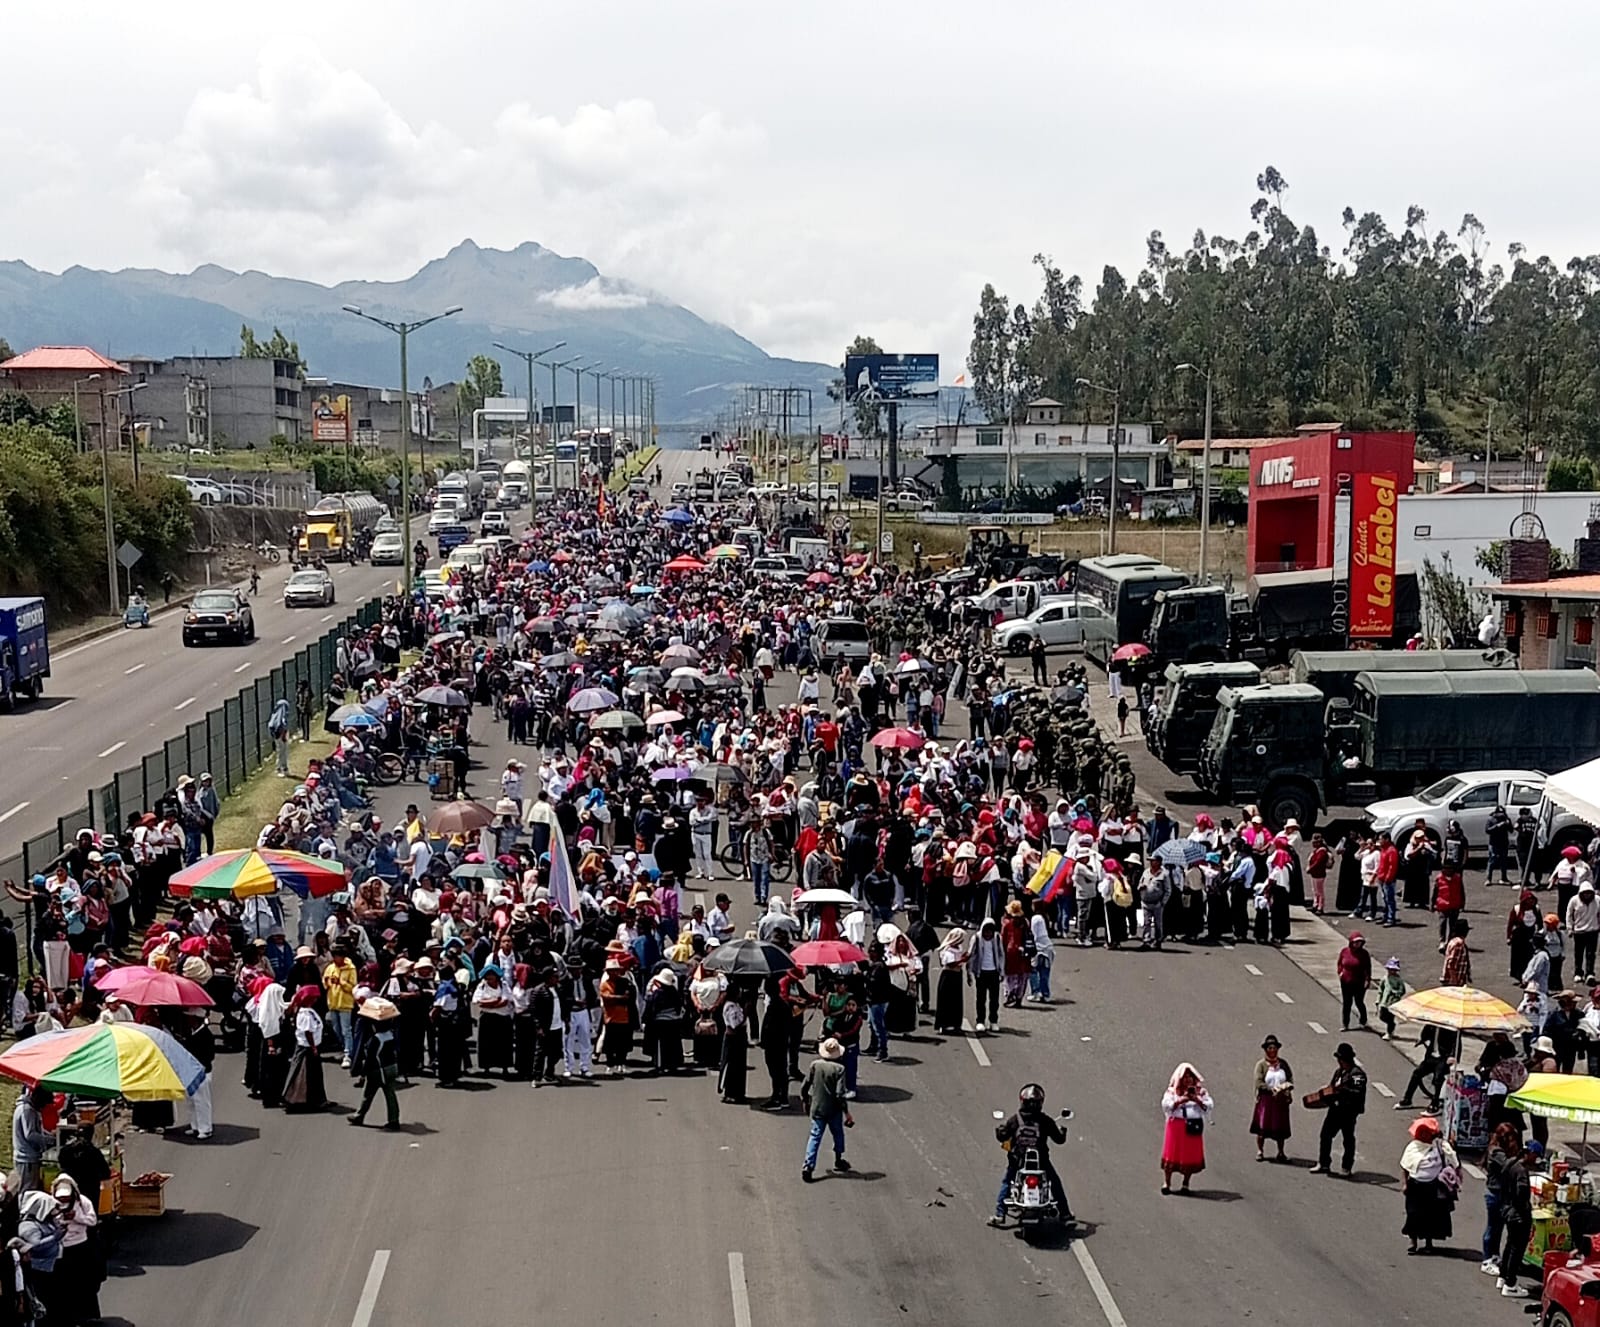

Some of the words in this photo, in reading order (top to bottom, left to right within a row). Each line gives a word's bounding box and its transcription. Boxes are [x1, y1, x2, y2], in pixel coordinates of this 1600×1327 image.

[1261, 456, 1294, 486] AUTOS
[1369, 476, 1395, 568] Isabel
[1353, 520, 1368, 566] Quinta
[1367, 573, 1392, 608] La
[1524, 1101, 1569, 1118] MANGO
